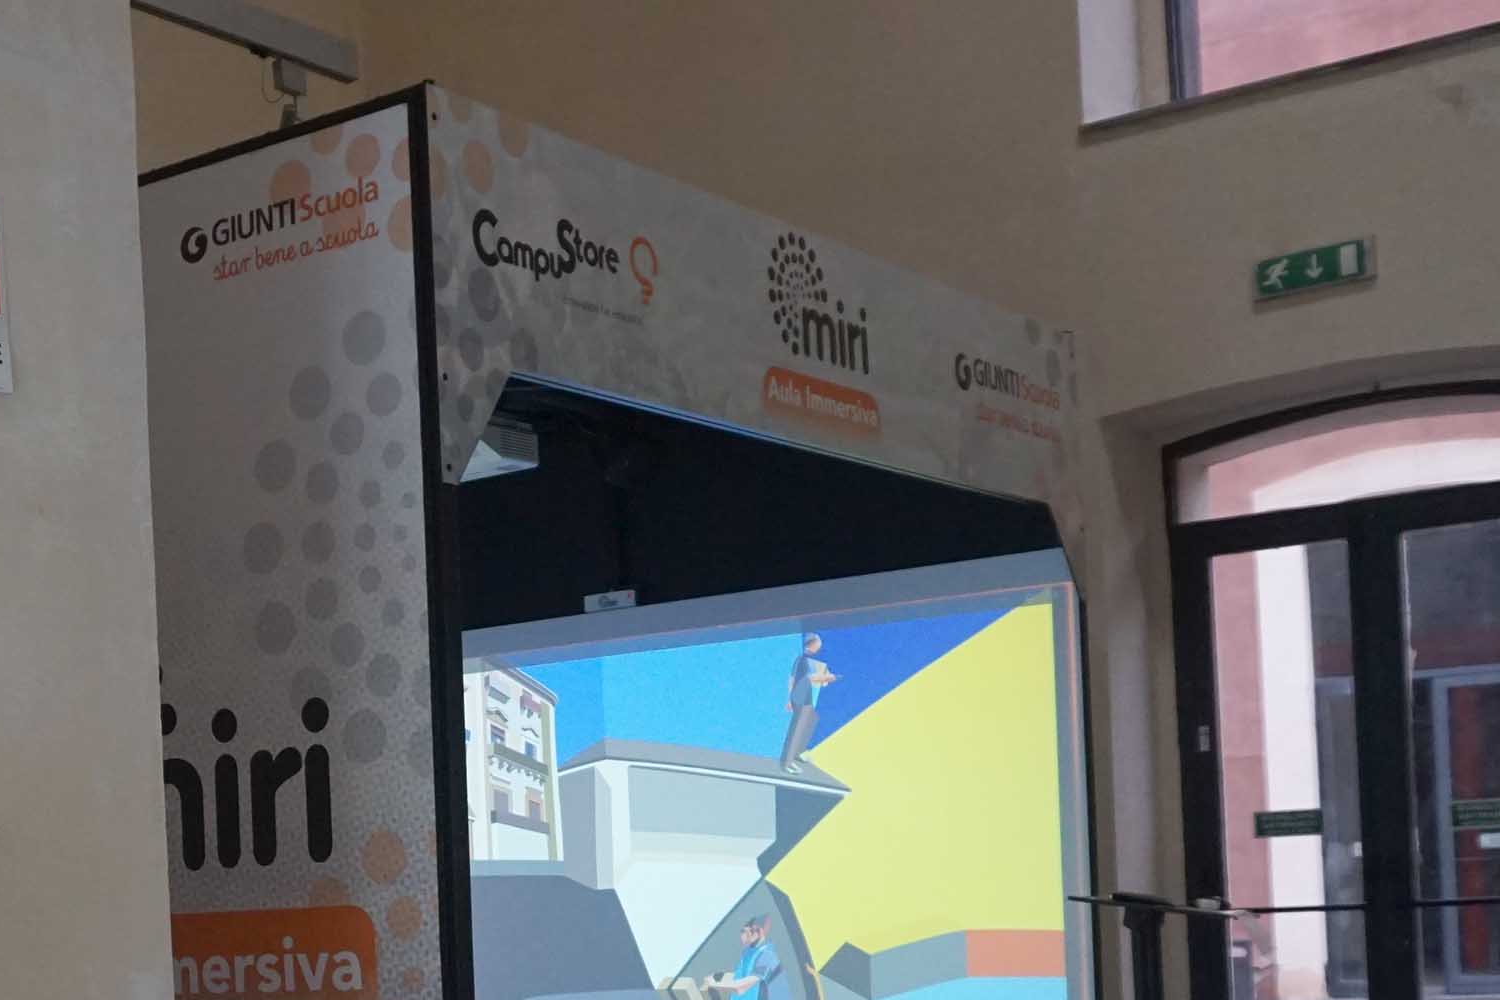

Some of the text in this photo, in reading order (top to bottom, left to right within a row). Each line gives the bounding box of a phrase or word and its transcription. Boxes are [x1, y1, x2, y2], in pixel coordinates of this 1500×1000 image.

[213, 219, 380, 280] star bene a scuola
[472, 209, 620, 281] CampuStore
[801, 299, 870, 375] miri
[805, 384, 879, 428] Immersiva
